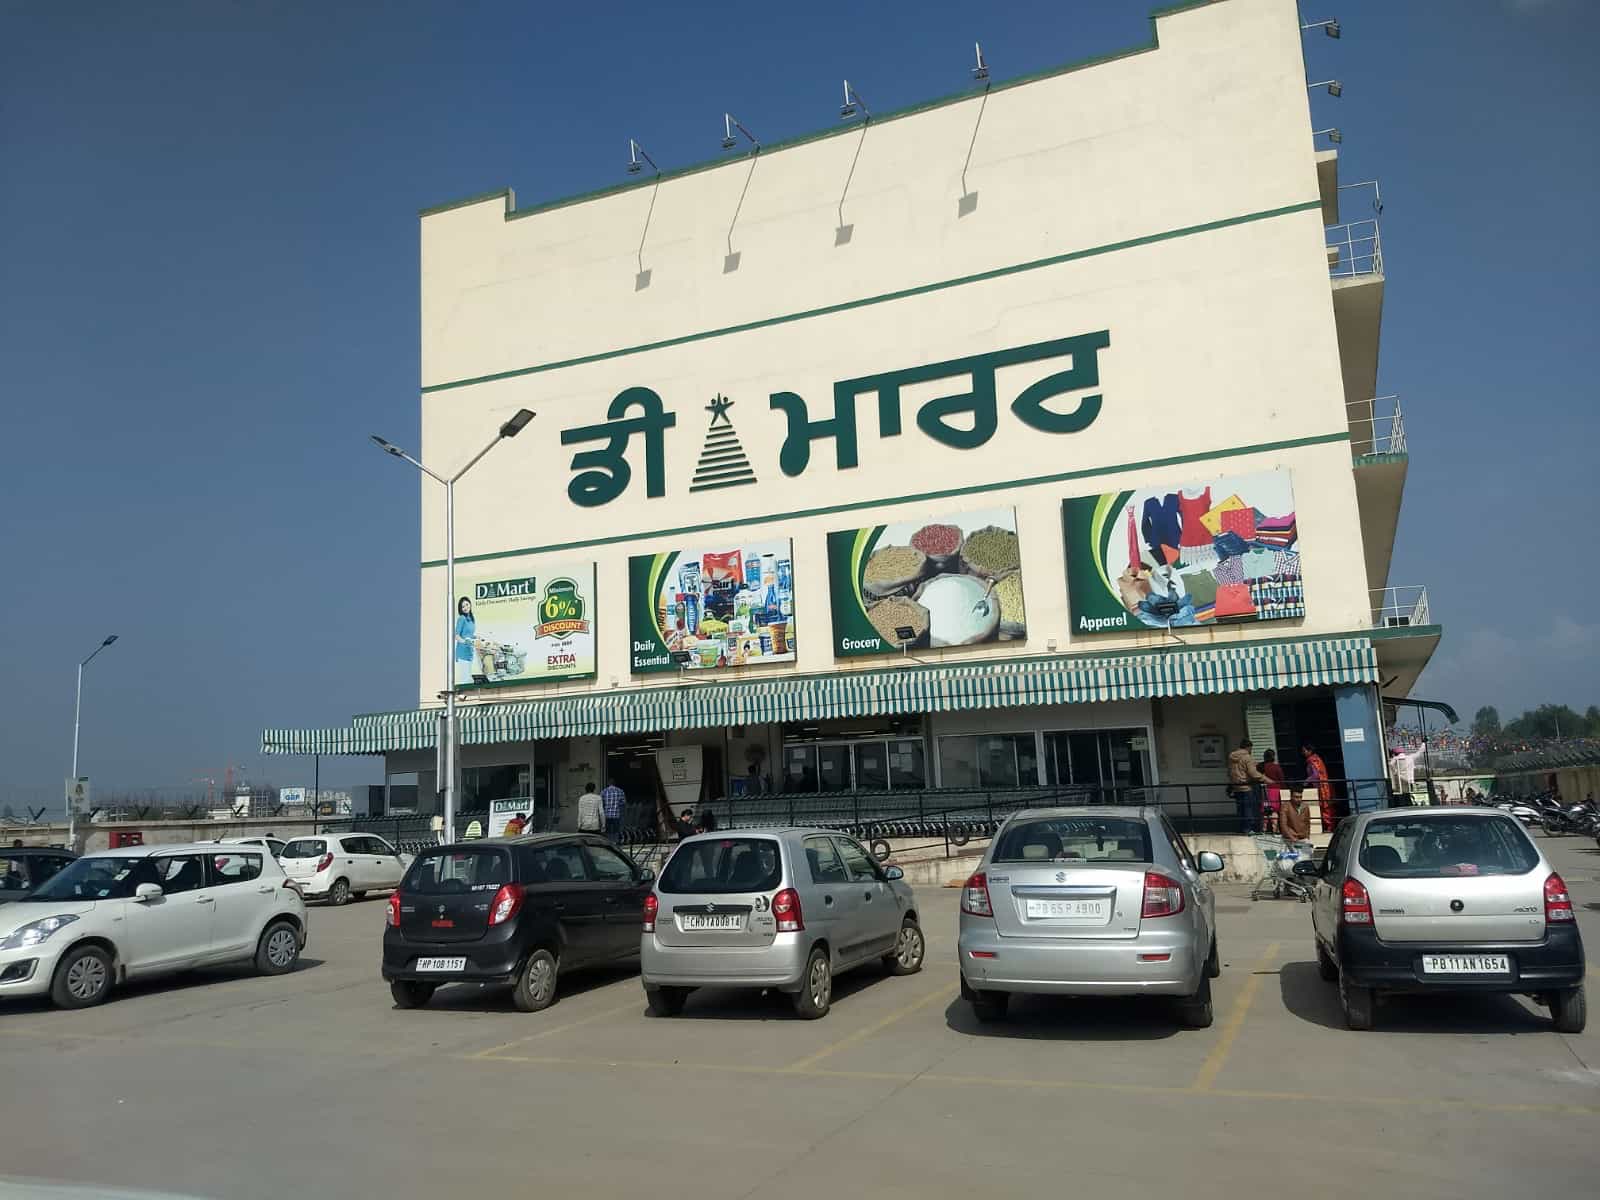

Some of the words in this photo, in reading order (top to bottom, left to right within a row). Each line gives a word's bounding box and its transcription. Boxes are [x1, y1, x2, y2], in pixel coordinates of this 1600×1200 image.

[561, 386, 676, 507] ਡੀ
[770, 330, 1110, 477] ਮਾਰਟ
[543, 622, 581, 633] DISCOUNT
[1079, 611, 1128, 631] Apparel
[634, 640, 655, 653] Daily
[842, 637, 881, 650] Grocery
[547, 653, 576, 665] EXTRA
[634, 656, 670, 667] Essential
